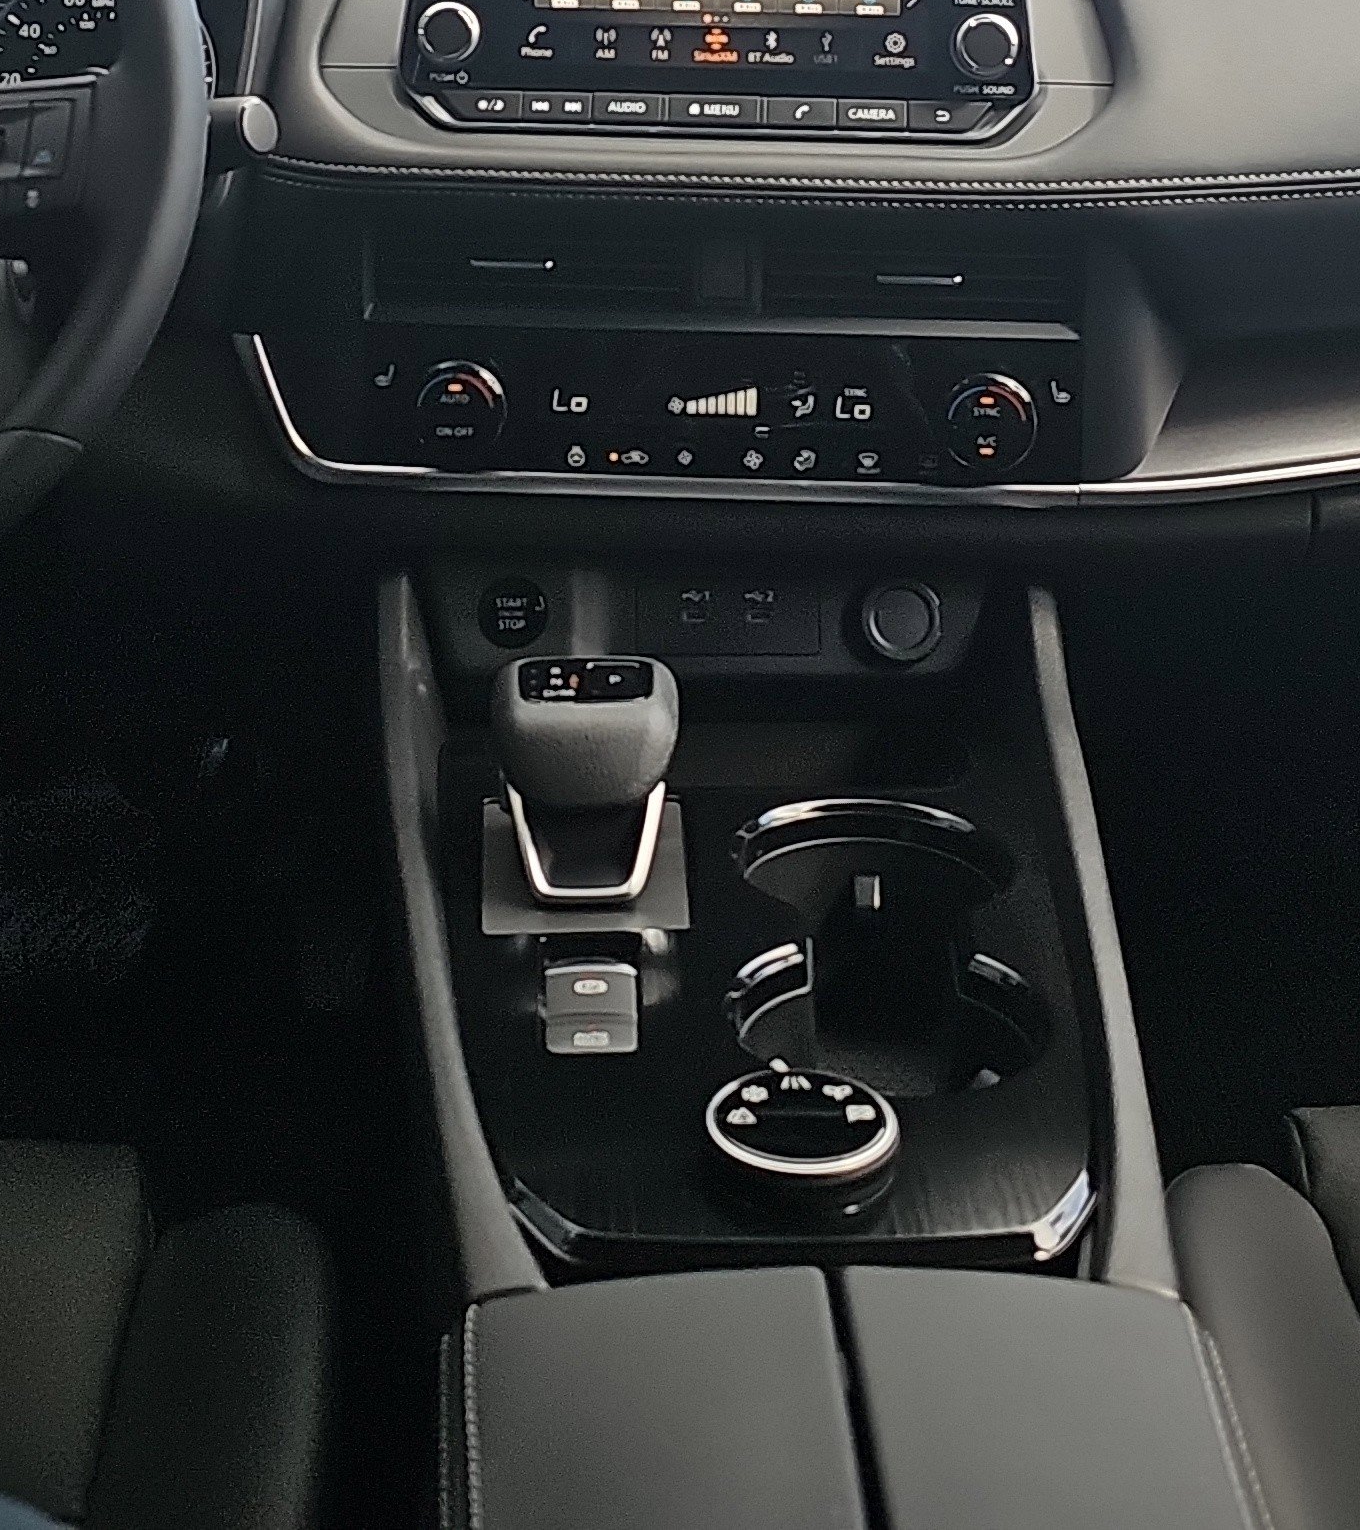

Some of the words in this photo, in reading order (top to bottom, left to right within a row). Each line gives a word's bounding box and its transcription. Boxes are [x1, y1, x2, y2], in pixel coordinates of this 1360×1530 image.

[18, 23, 41, 39] 40
[520, 46, 554, 58] Phone
[595, 48, 616, 59] AM
[652, 49, 669, 60] FM
[747, 53, 762, 63] BT
[763, 53, 795, 64] Audio
[873, 55, 916, 68] Settings
[0, 72, 22, 86] 20
[982, 84, 1015, 96] SOUND
[607, 101, 647, 114] AUDIO
[703, 103, 740, 116] MENU
[846, 107, 896, 121] CAMERA
[440, 394, 471, 405] AUTO
[552, 388, 589, 413] Lo
[835, 394, 871, 420] Lo
[972, 406, 1001, 418] SYNC
[977, 435, 997, 447] A/C
[495, 597, 527, 608] START
[498, 619, 527, 630] STOP
